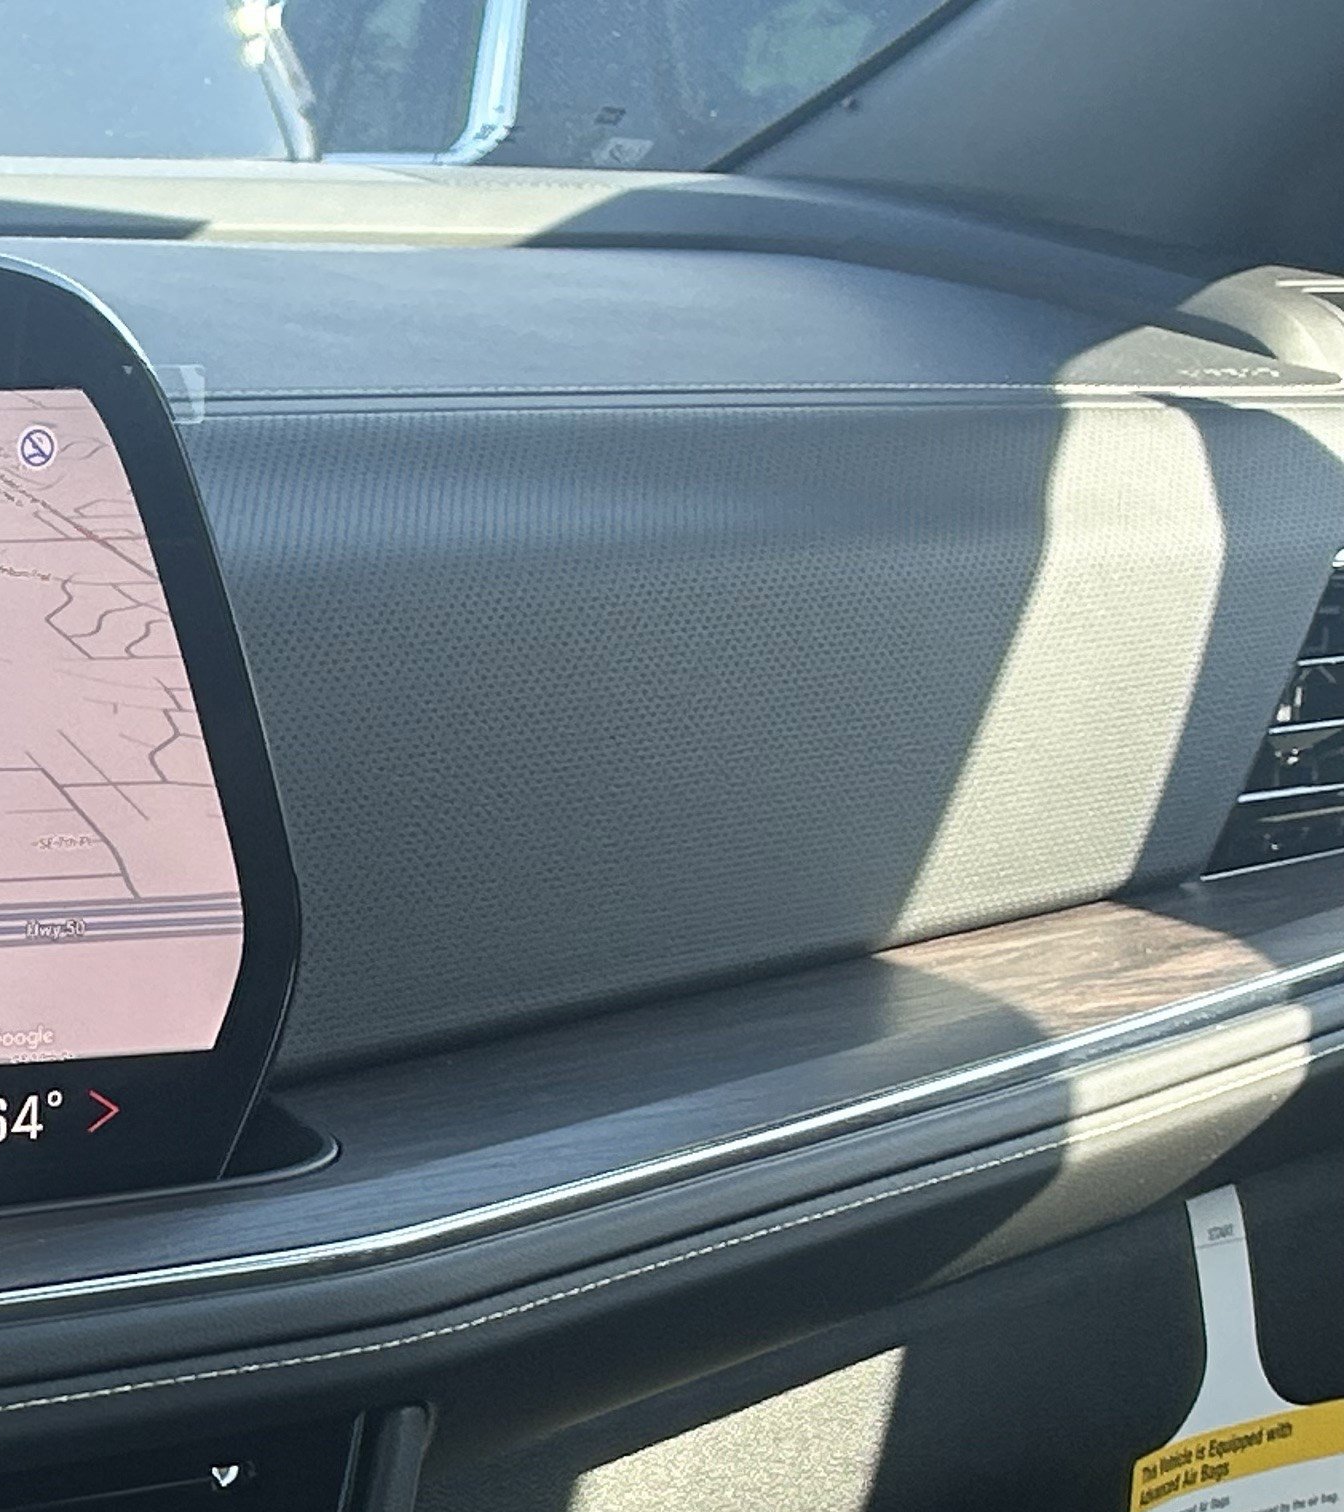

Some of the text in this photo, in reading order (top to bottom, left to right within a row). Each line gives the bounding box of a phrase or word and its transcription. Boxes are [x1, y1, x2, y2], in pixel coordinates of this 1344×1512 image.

[27, 920, 85, 938] Hwy 50
[1208, 1430, 1263, 1458] Equipped
[1266, 1422, 1293, 1442] with
[1183, 1469, 1197, 1487] Air
[1201, 1462, 1229, 1482] Bags
